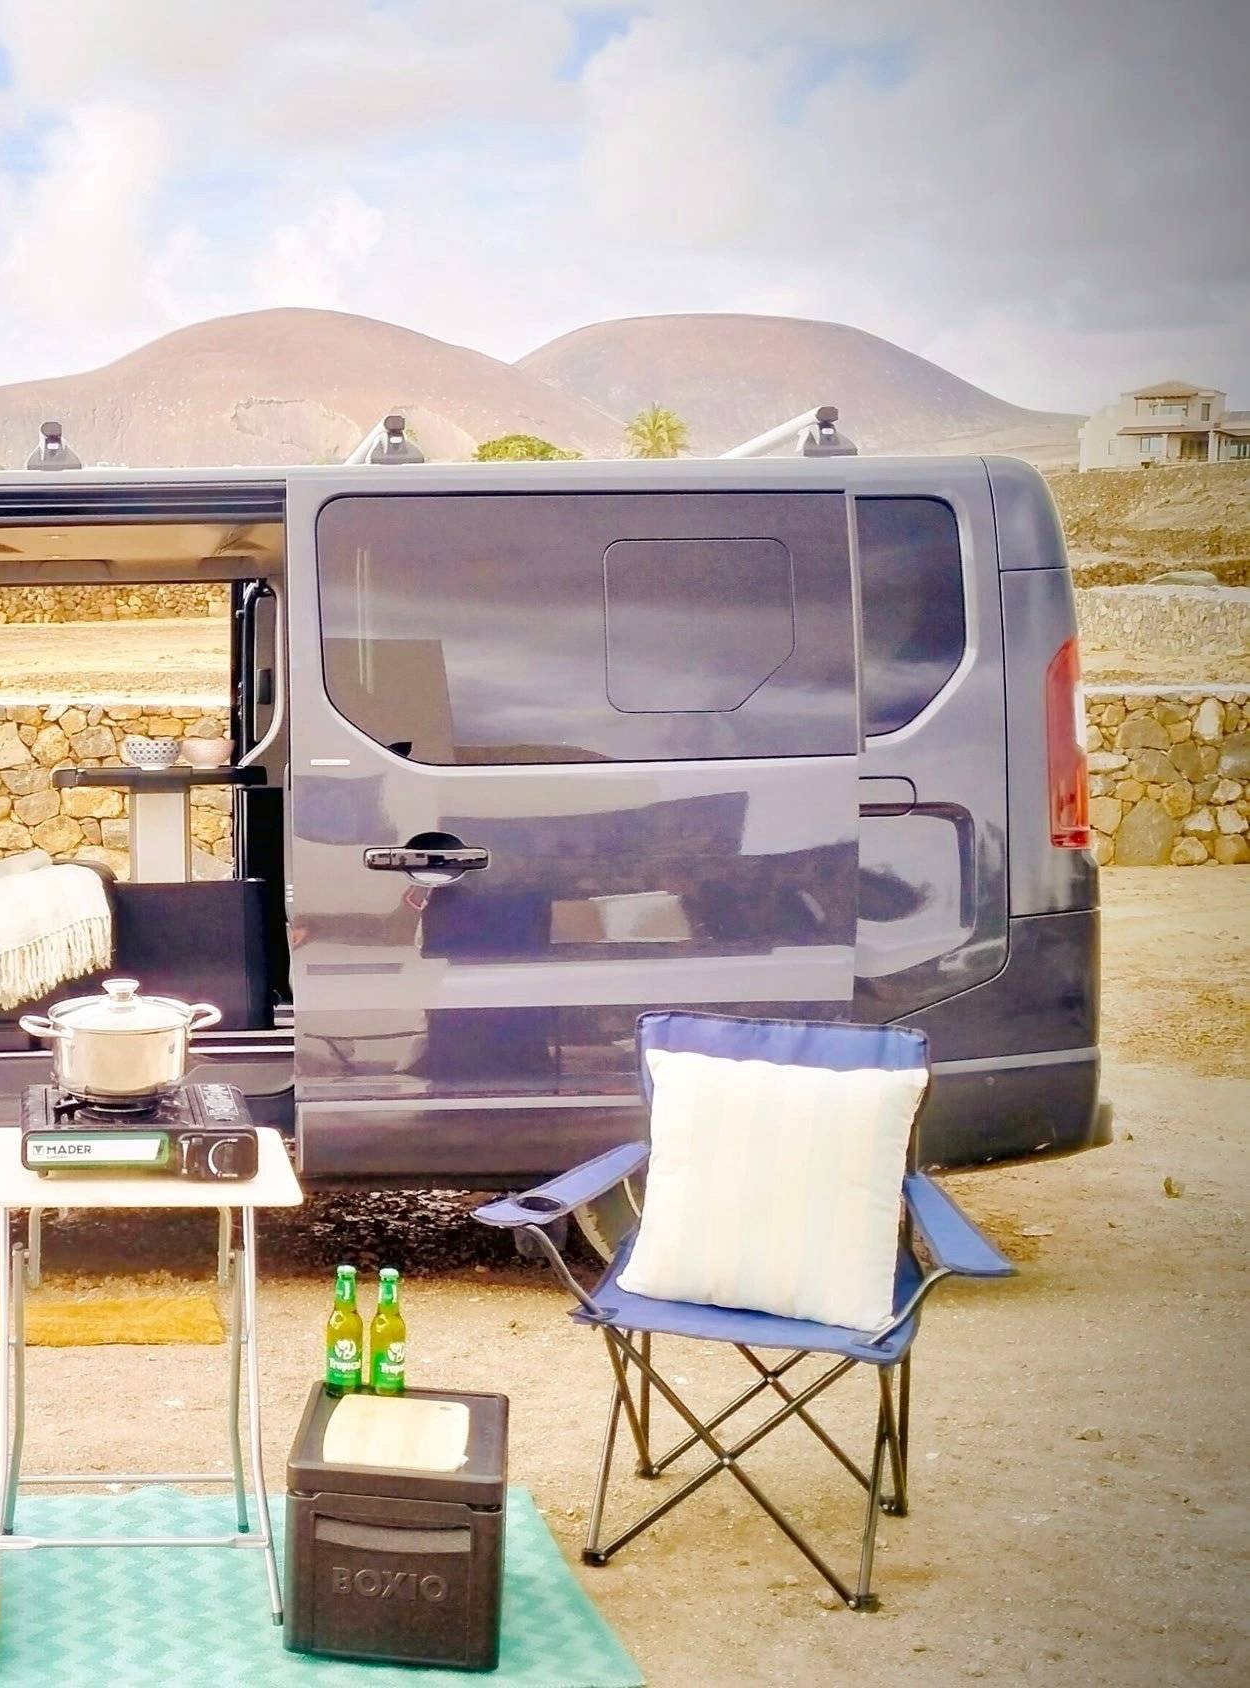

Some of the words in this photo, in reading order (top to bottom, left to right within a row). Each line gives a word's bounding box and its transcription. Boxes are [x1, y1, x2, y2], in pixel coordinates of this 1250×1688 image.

[46, 1145, 92, 1155] MADER
[328, 1357, 361, 1373] Tropical
[332, 1567, 449, 1602] BOXIO
